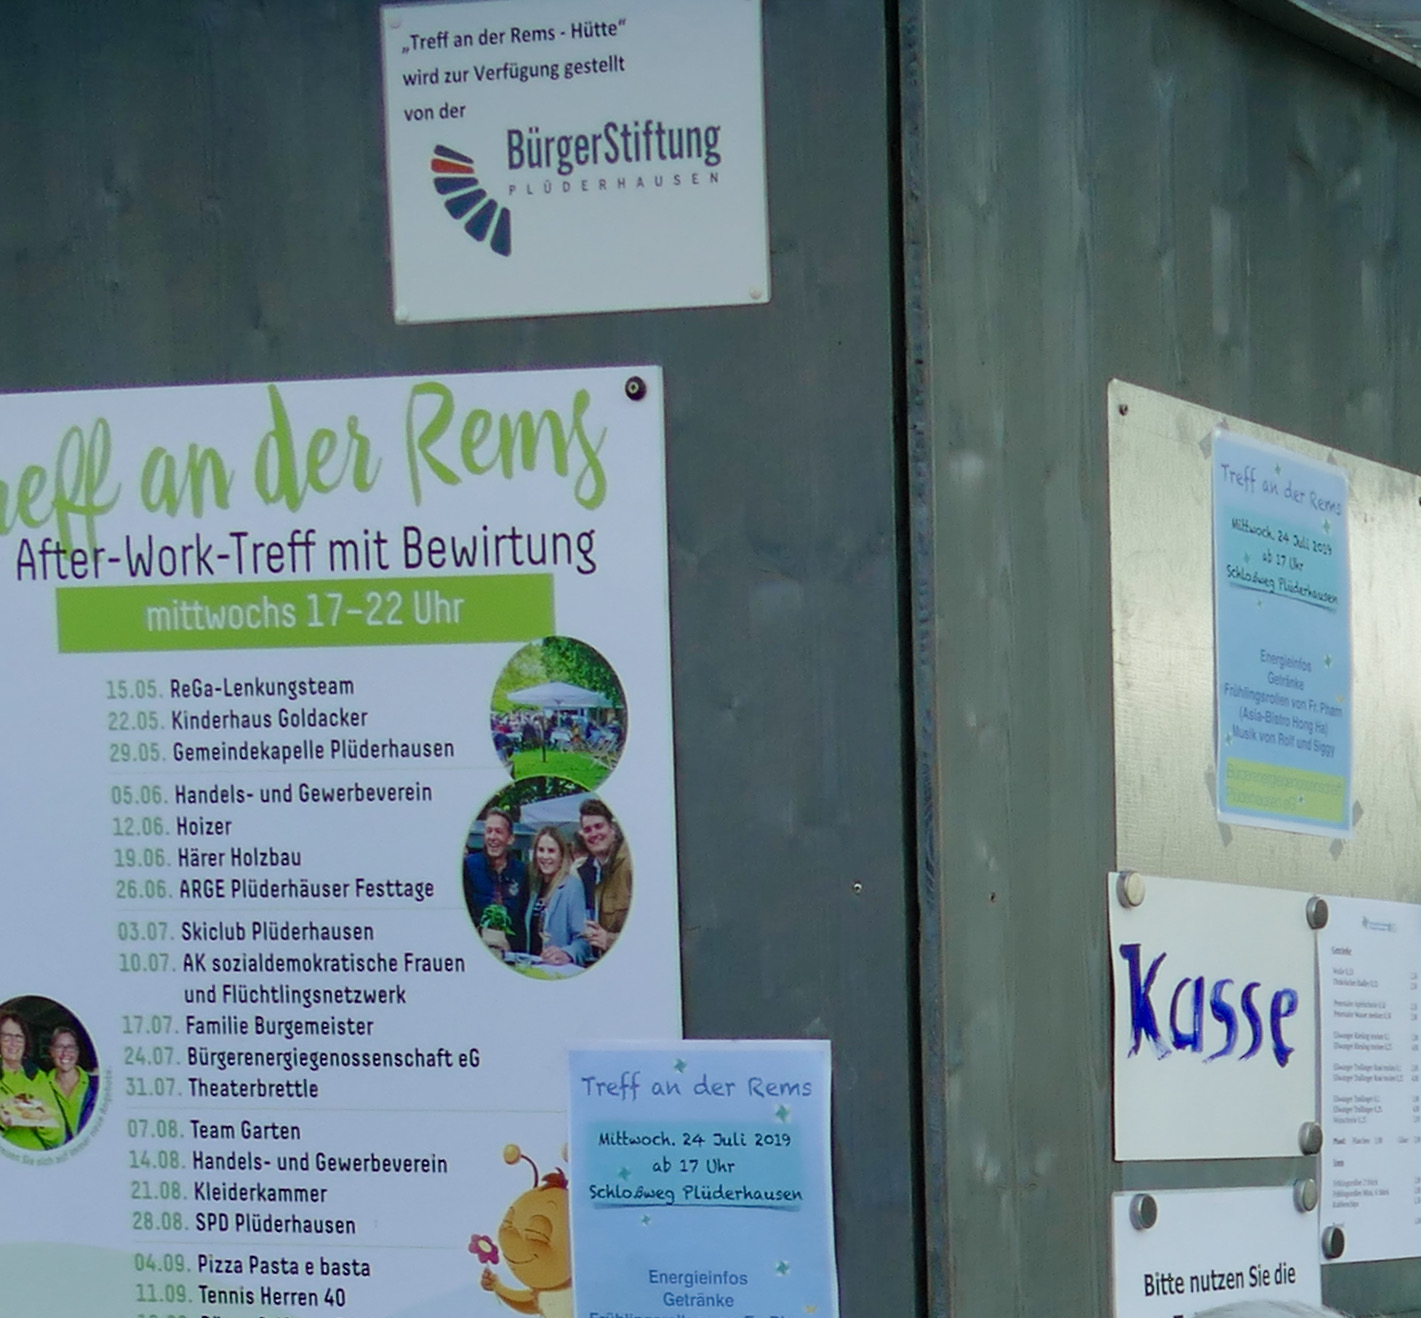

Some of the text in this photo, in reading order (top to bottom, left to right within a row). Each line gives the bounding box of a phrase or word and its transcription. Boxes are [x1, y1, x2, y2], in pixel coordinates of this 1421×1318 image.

[454, 34, 473, 47] an
[478, 28, 505, 45] der
[511, 27, 555, 43] Rems
[403, 55, 625, 86] wird zur Verfügung gestellt
[404, 102, 466, 121] von der
[507, 120, 721, 176] BürgerStiftung
[509, 172, 718, 196] PLÜDERHAUSEN
[141, 442, 235, 519] an
[254, 383, 381, 513] der
[405, 381, 607, 511] Rems
[1221, 464, 1341, 516] Treff an der Rems
[16, 523, 596, 582] After-Work-Treff mit Bewirtung
[147, 590, 464, 631] mittwochs 17-22 Uhr
[106, 677, 354, 700] 15.05. ReGa-Lenkungsteam
[108, 707, 368, 731] 22.05. Kinderhaus Goldacker
[110, 738, 454, 764] 29.05. Gemeindekapelle Plüderhausen
[111, 782, 432, 805] 05.06. Handels- und Gewerbeverein
[113, 816, 232, 836] 12.06. Hoizer
[114, 847, 301, 867] 19.06. Härer Holzbau
[116, 878, 433, 902] 26.06. ARGE Plüderhäuser Festtage
[118, 921, 373, 941] 03.07. Skiclub Plüderhausen
[119, 953, 464, 972] 10.07. AK sozialdemokratische Frauen
[185, 984, 406, 1008] und Flüchtlingsnetzwerk
[1119, 944, 1298, 1068] Kasse
[122, 1015, 374, 1039] 17.07. Familie Burgemeister
[124, 1046, 479, 1071] 24.07. Bürgerenergiegenossenschaft eG
[126, 1077, 318, 1098] 31.07. Theaterbrettle
[581, 1071, 812, 1101] Treff an der Rems
[128, 1119, 300, 1139] 07.08. Team Garten
[683, 1133, 705, 1147] 24
[713, 1132, 747, 1146] Juli
[755, 1133, 790, 1146] 2019
[129, 1150, 447, 1173] 14.08. Handels- und Gewerbeverein
[653, 1156, 735, 1173] ab 17 Uhr
[131, 1180, 327, 1202] 21.08. Kleiderkammer
[589, 1184, 804, 1205] Schloßweg Plüderhausen
[133, 1211, 355, 1234] 28.08. SPD Plüderhausen
[134, 1253, 370, 1276] 04.09. Pizza Pasta e basta
[649, 1270, 748, 1288] Energieinfos
[1144, 1262, 1295, 1296] Bitte nutzen Sie die
[136, 1284, 345, 1307] 11.09. Tennis Herren 40
[663, 1292, 734, 1307] Getränke
